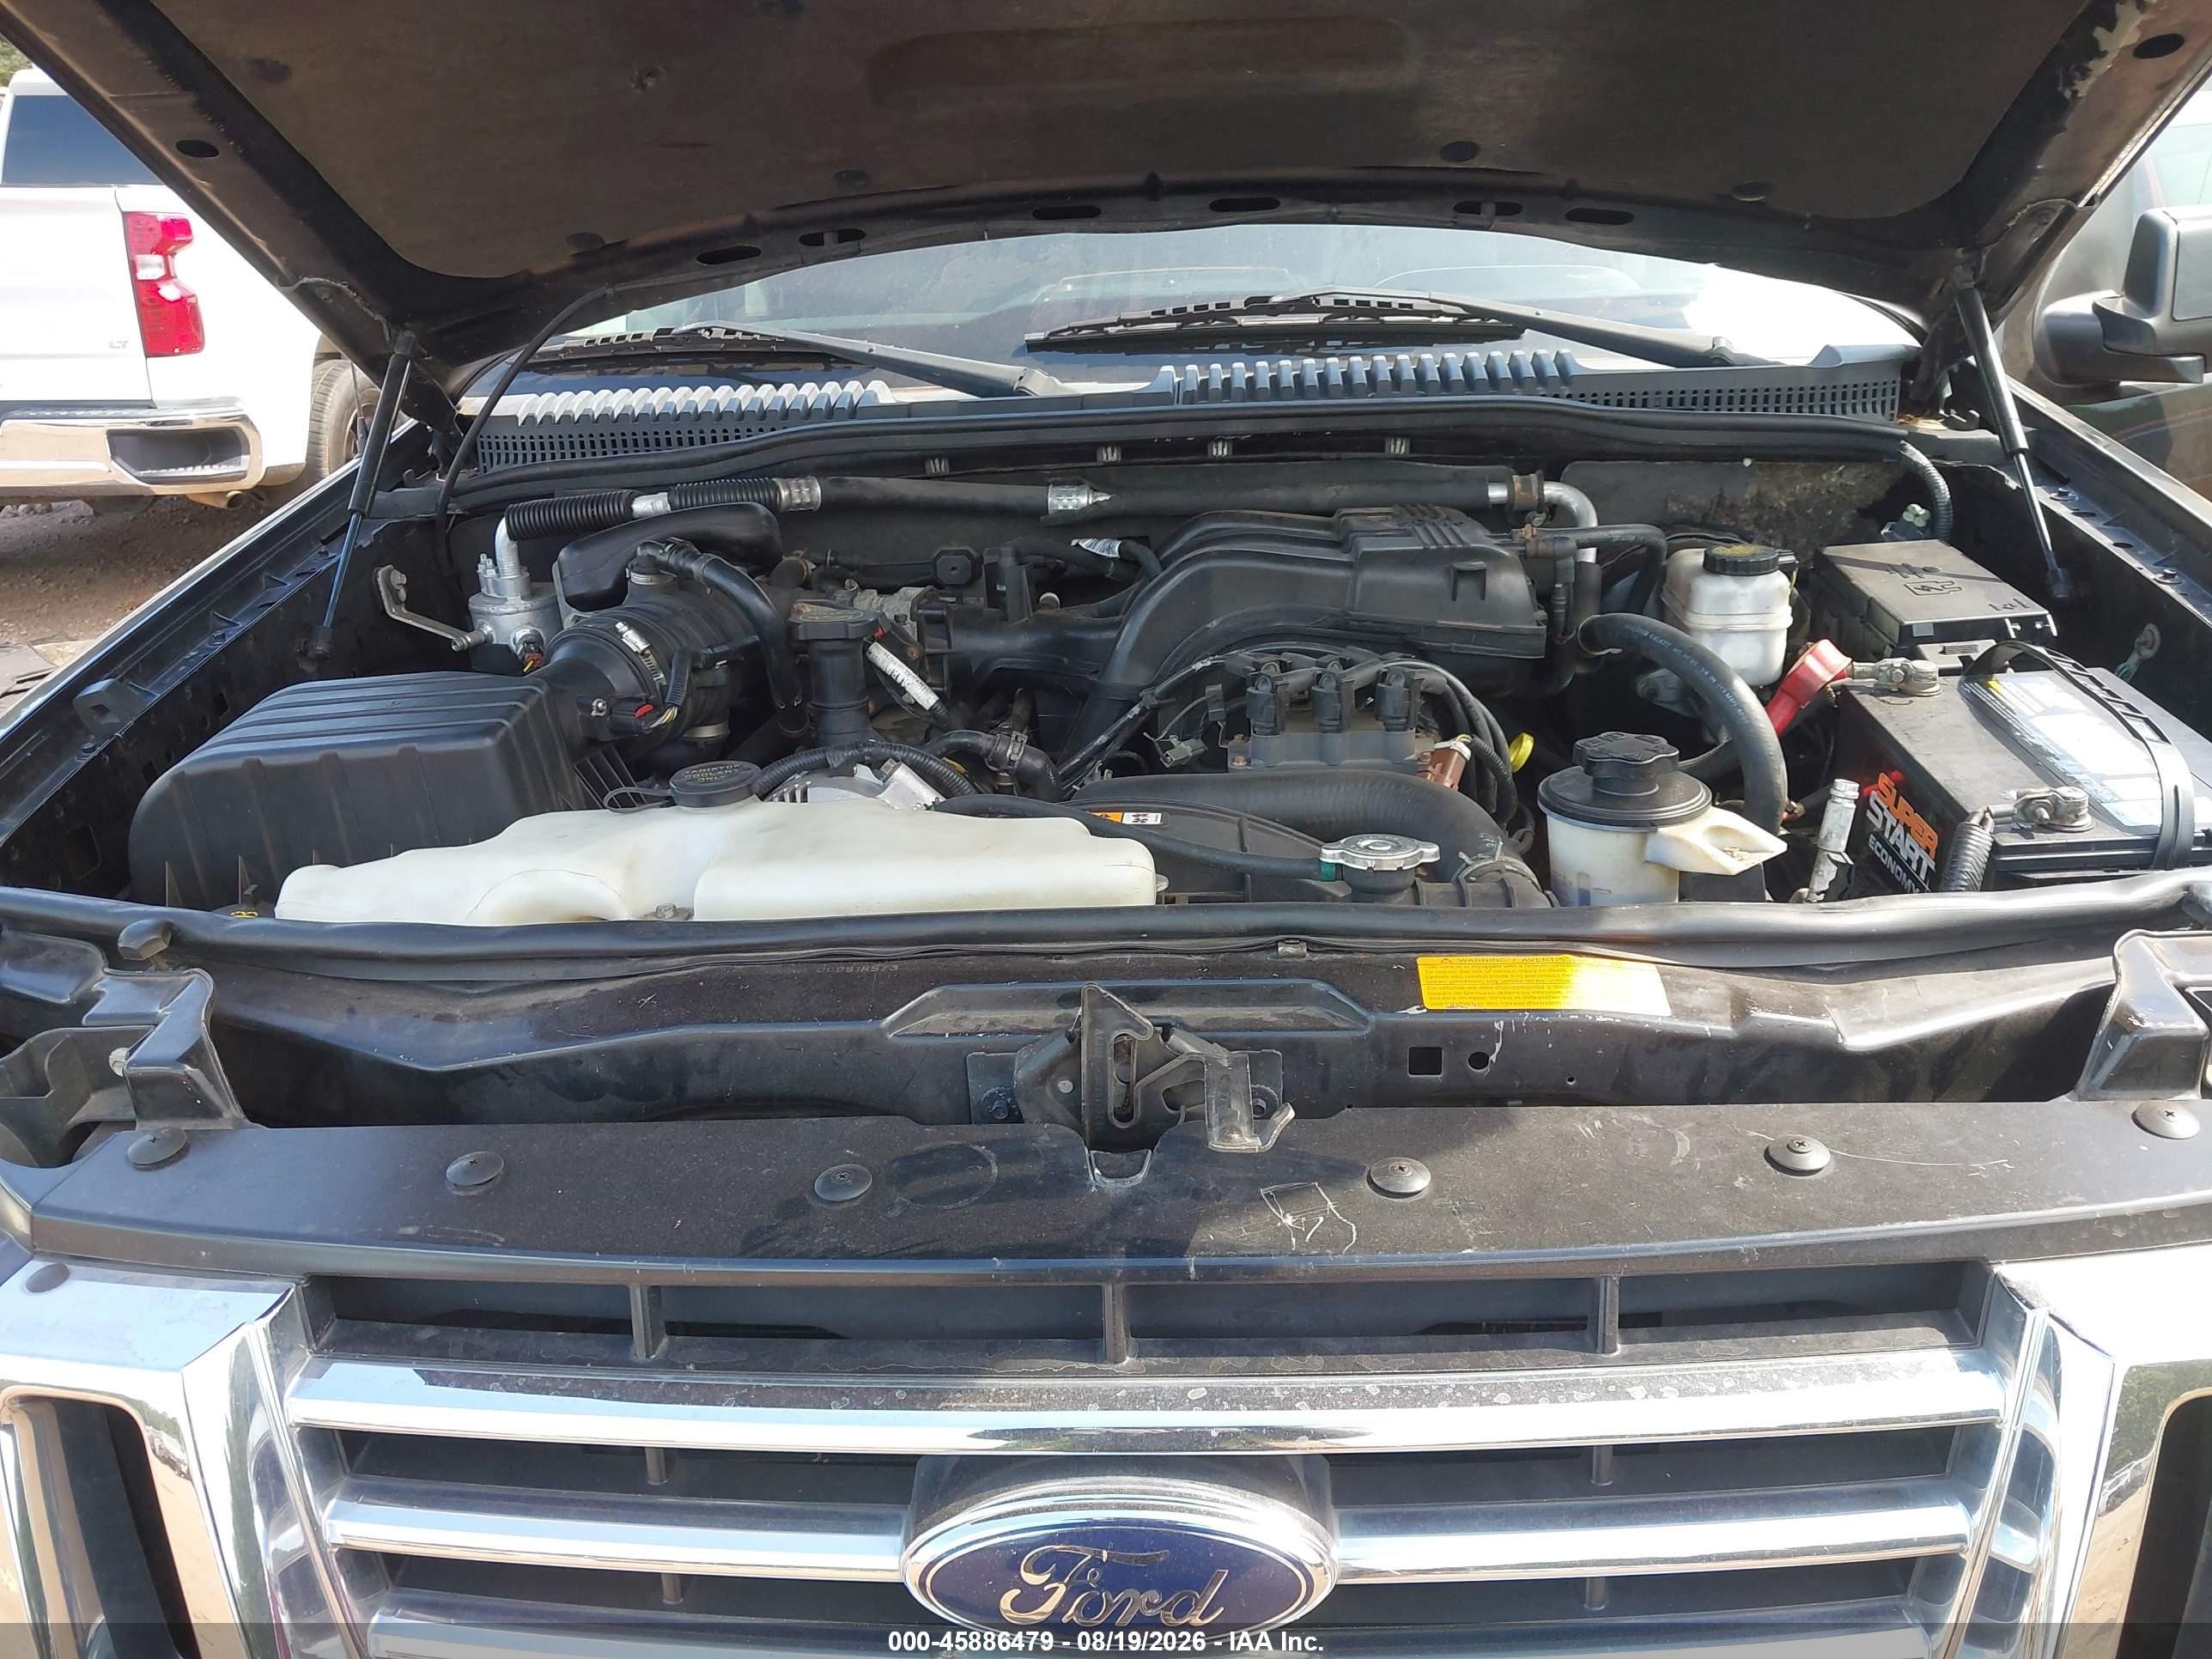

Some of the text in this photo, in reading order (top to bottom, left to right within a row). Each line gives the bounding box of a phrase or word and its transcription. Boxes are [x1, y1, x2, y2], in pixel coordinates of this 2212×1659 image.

[107, 340, 130, 349] LT
[1866, 790, 1936, 881] START
[1876, 772, 1938, 860] SUPER
[1000, 1544, 1229, 1628] Ford
